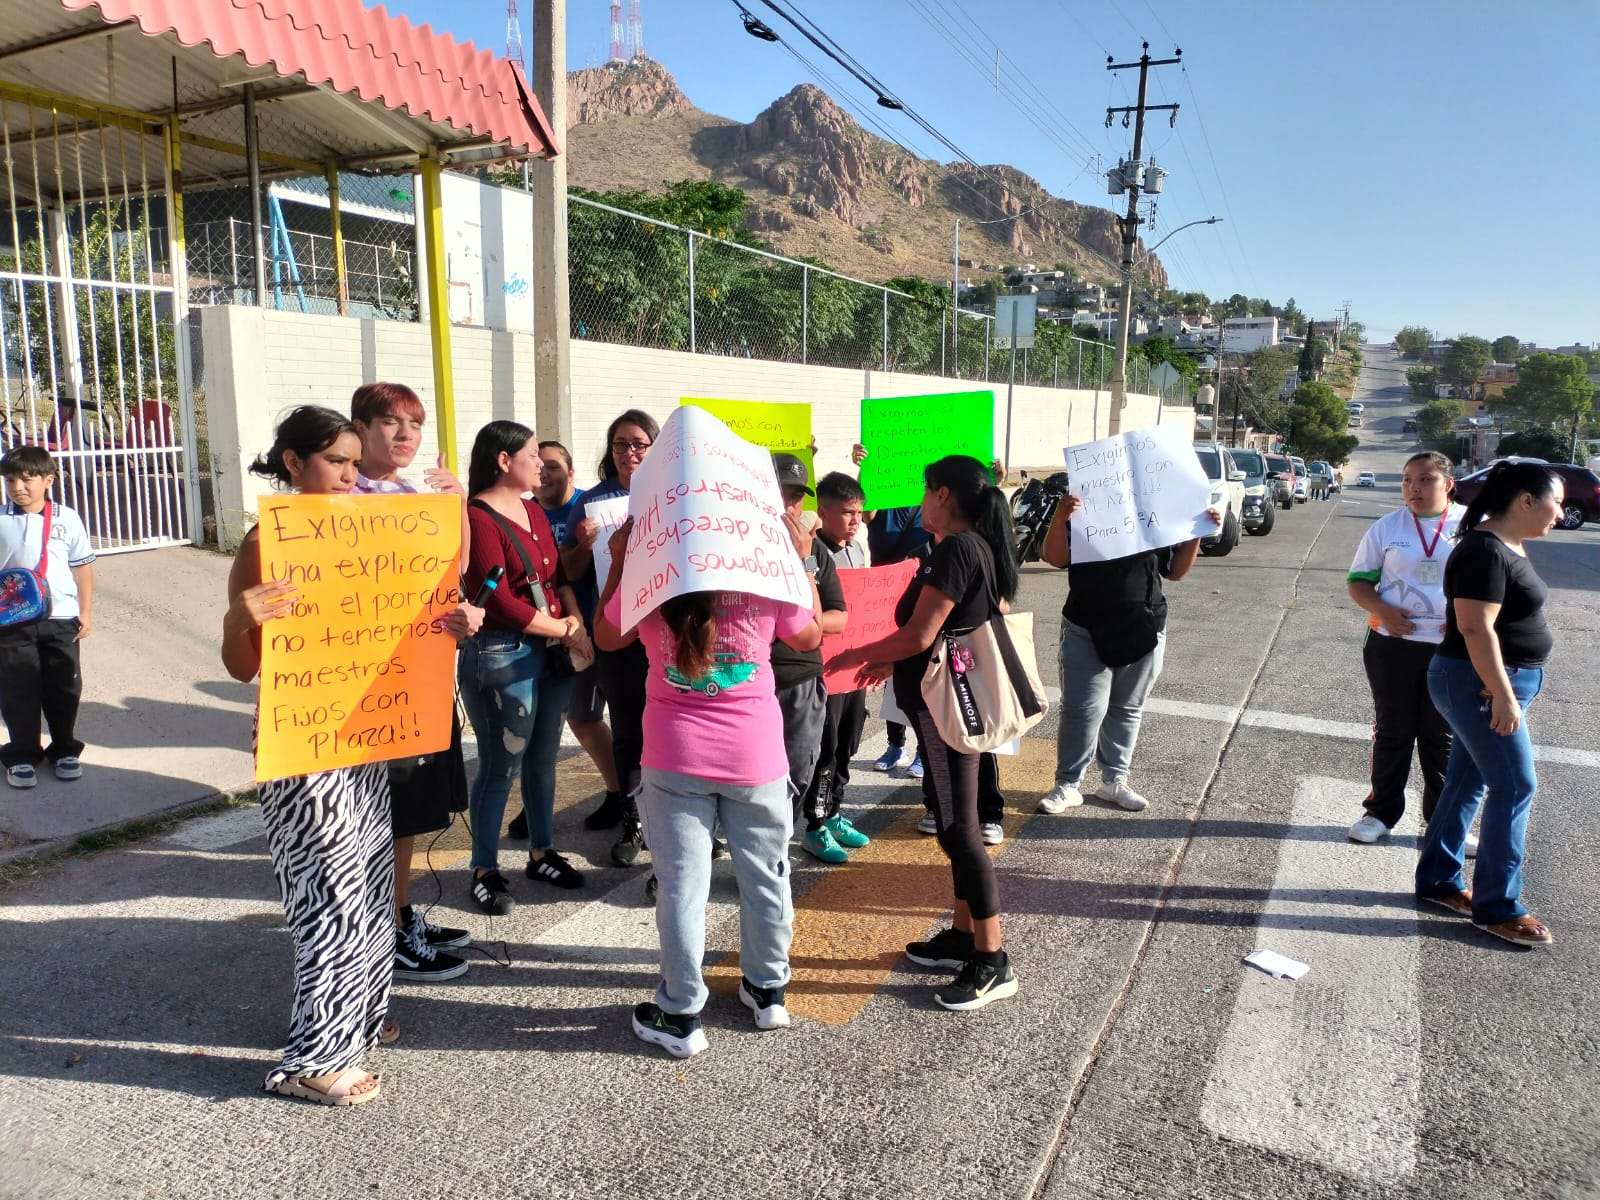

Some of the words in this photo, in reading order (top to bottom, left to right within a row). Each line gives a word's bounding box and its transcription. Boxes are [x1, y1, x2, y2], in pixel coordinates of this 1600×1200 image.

[1071, 436, 1157, 472] Exigimos
[1081, 468, 1136, 491] maestro
[269, 506, 439, 548] Exigimos
[646, 515, 750, 559] derechos
[687, 547, 802, 597] Hagamos
[340, 592, 362, 616] el
[721, 593, 745, 606] GIRL
[272, 633, 305, 653] no
[320, 617, 444, 648] tenemos
[273, 655, 407, 690] maestros
[360, 688, 409, 715] con
[959, 683, 978, 728] MINKOFF
